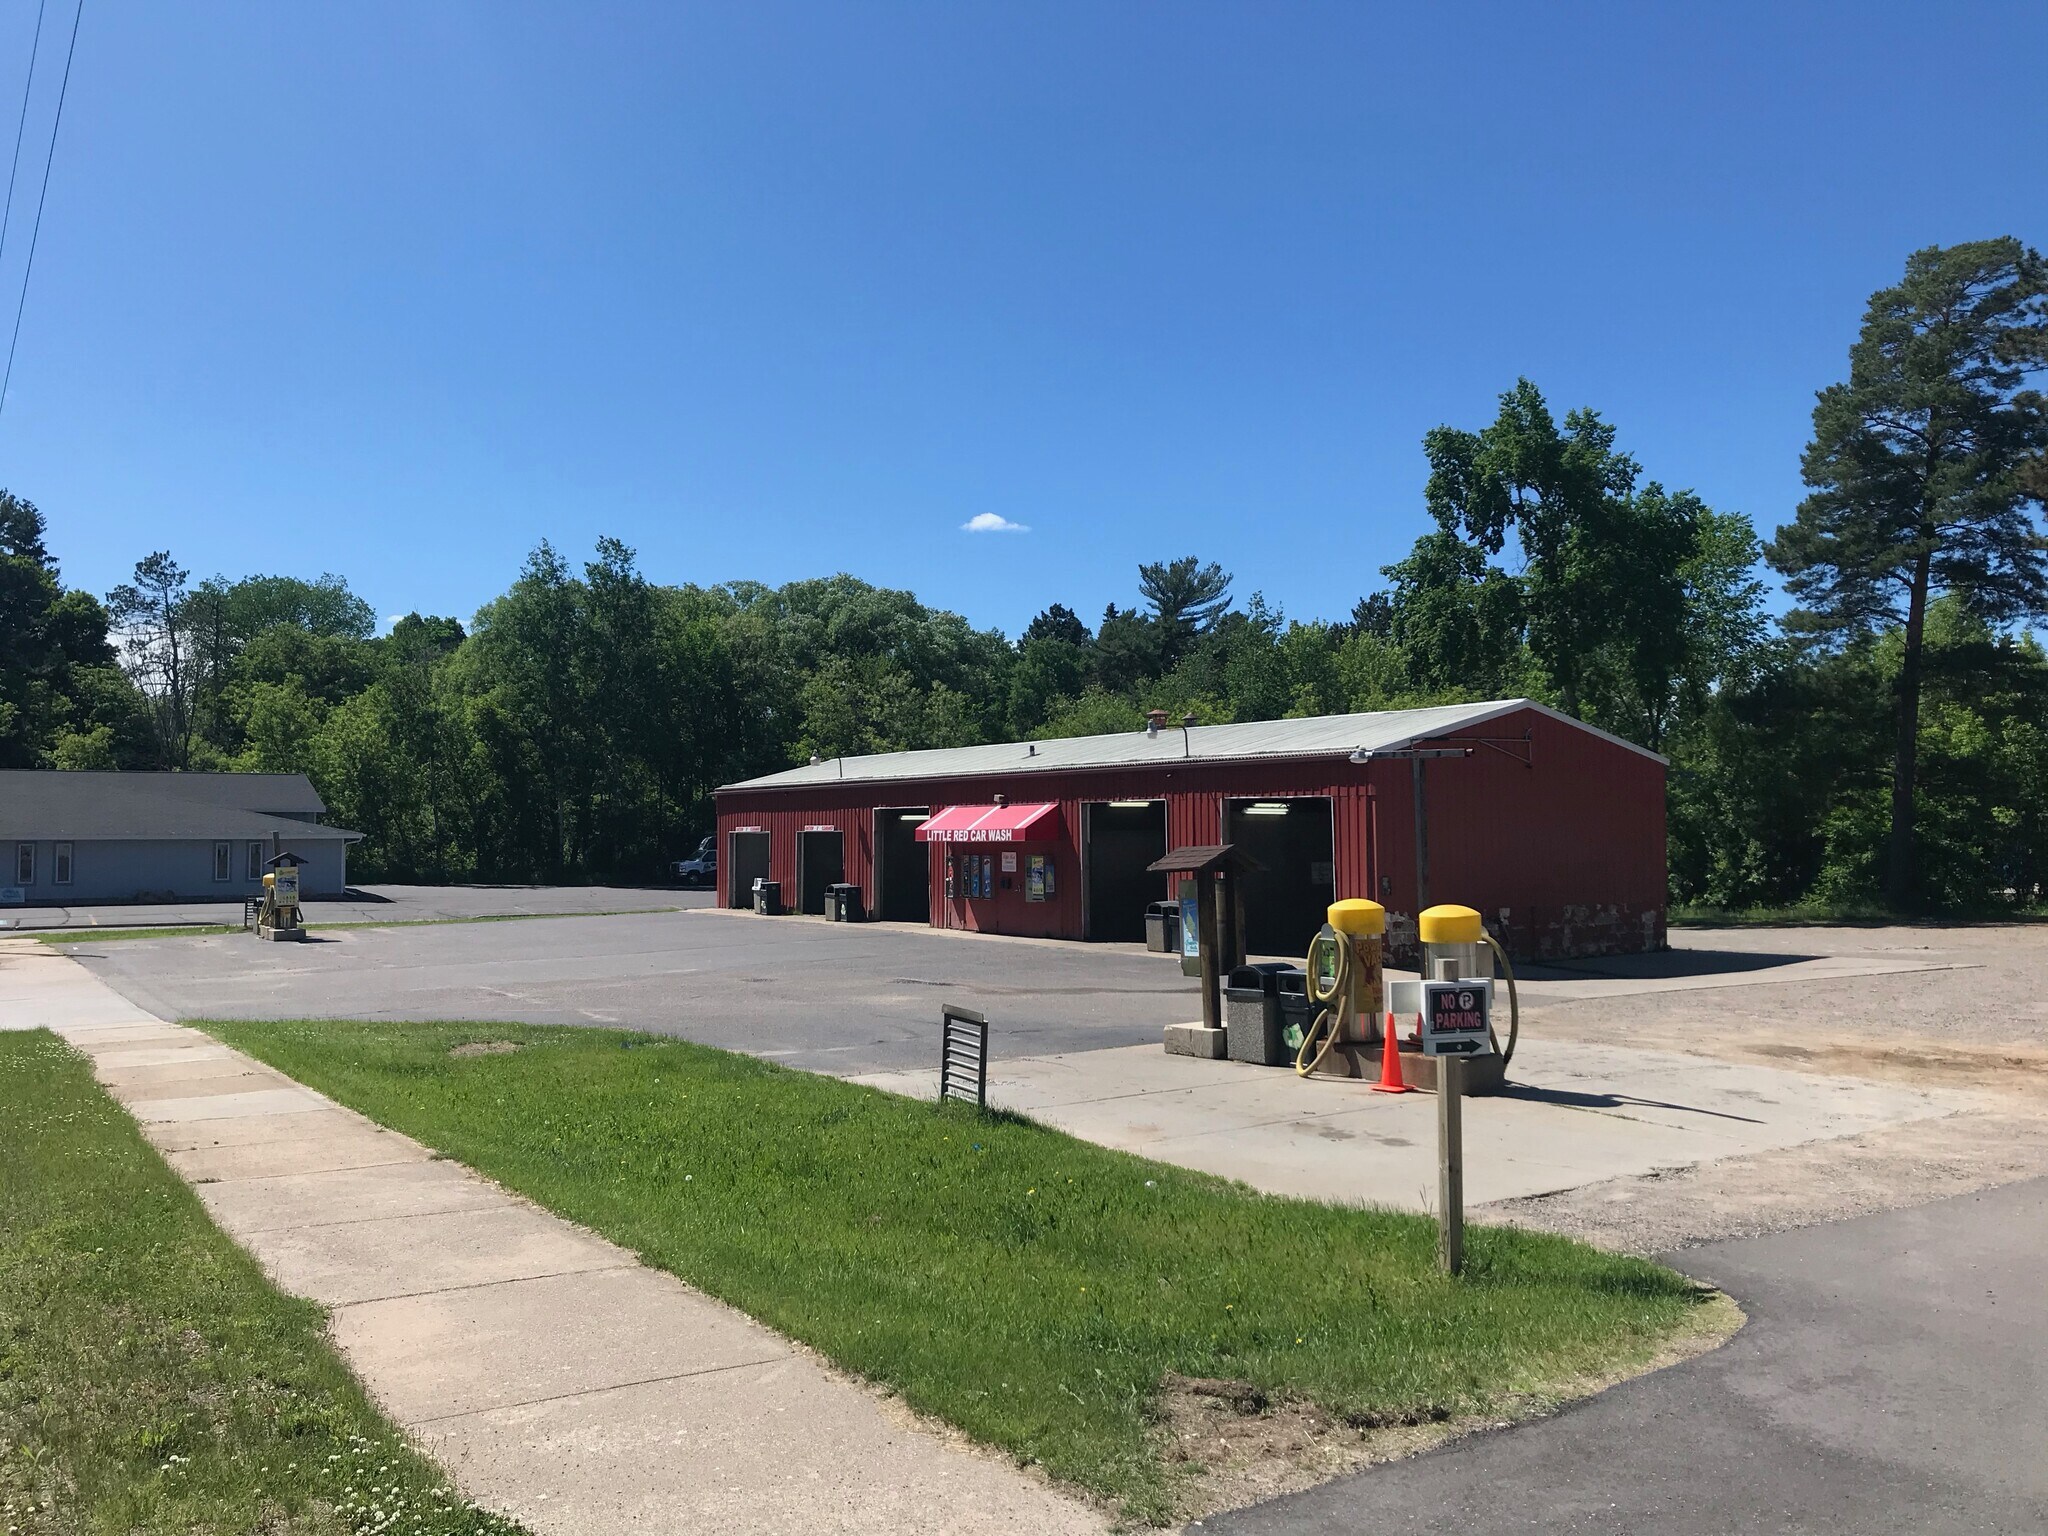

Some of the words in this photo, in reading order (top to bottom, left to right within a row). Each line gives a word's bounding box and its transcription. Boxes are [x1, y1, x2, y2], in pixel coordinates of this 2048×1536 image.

[926, 829, 952, 842] LITTLE
[953, 829, 969, 842] RED
[970, 829, 987, 842] CAR
[988, 828, 1012, 841] WASH
[1440, 993, 1456, 1010] NO
[1435, 1011, 1481, 1029] PARKING
